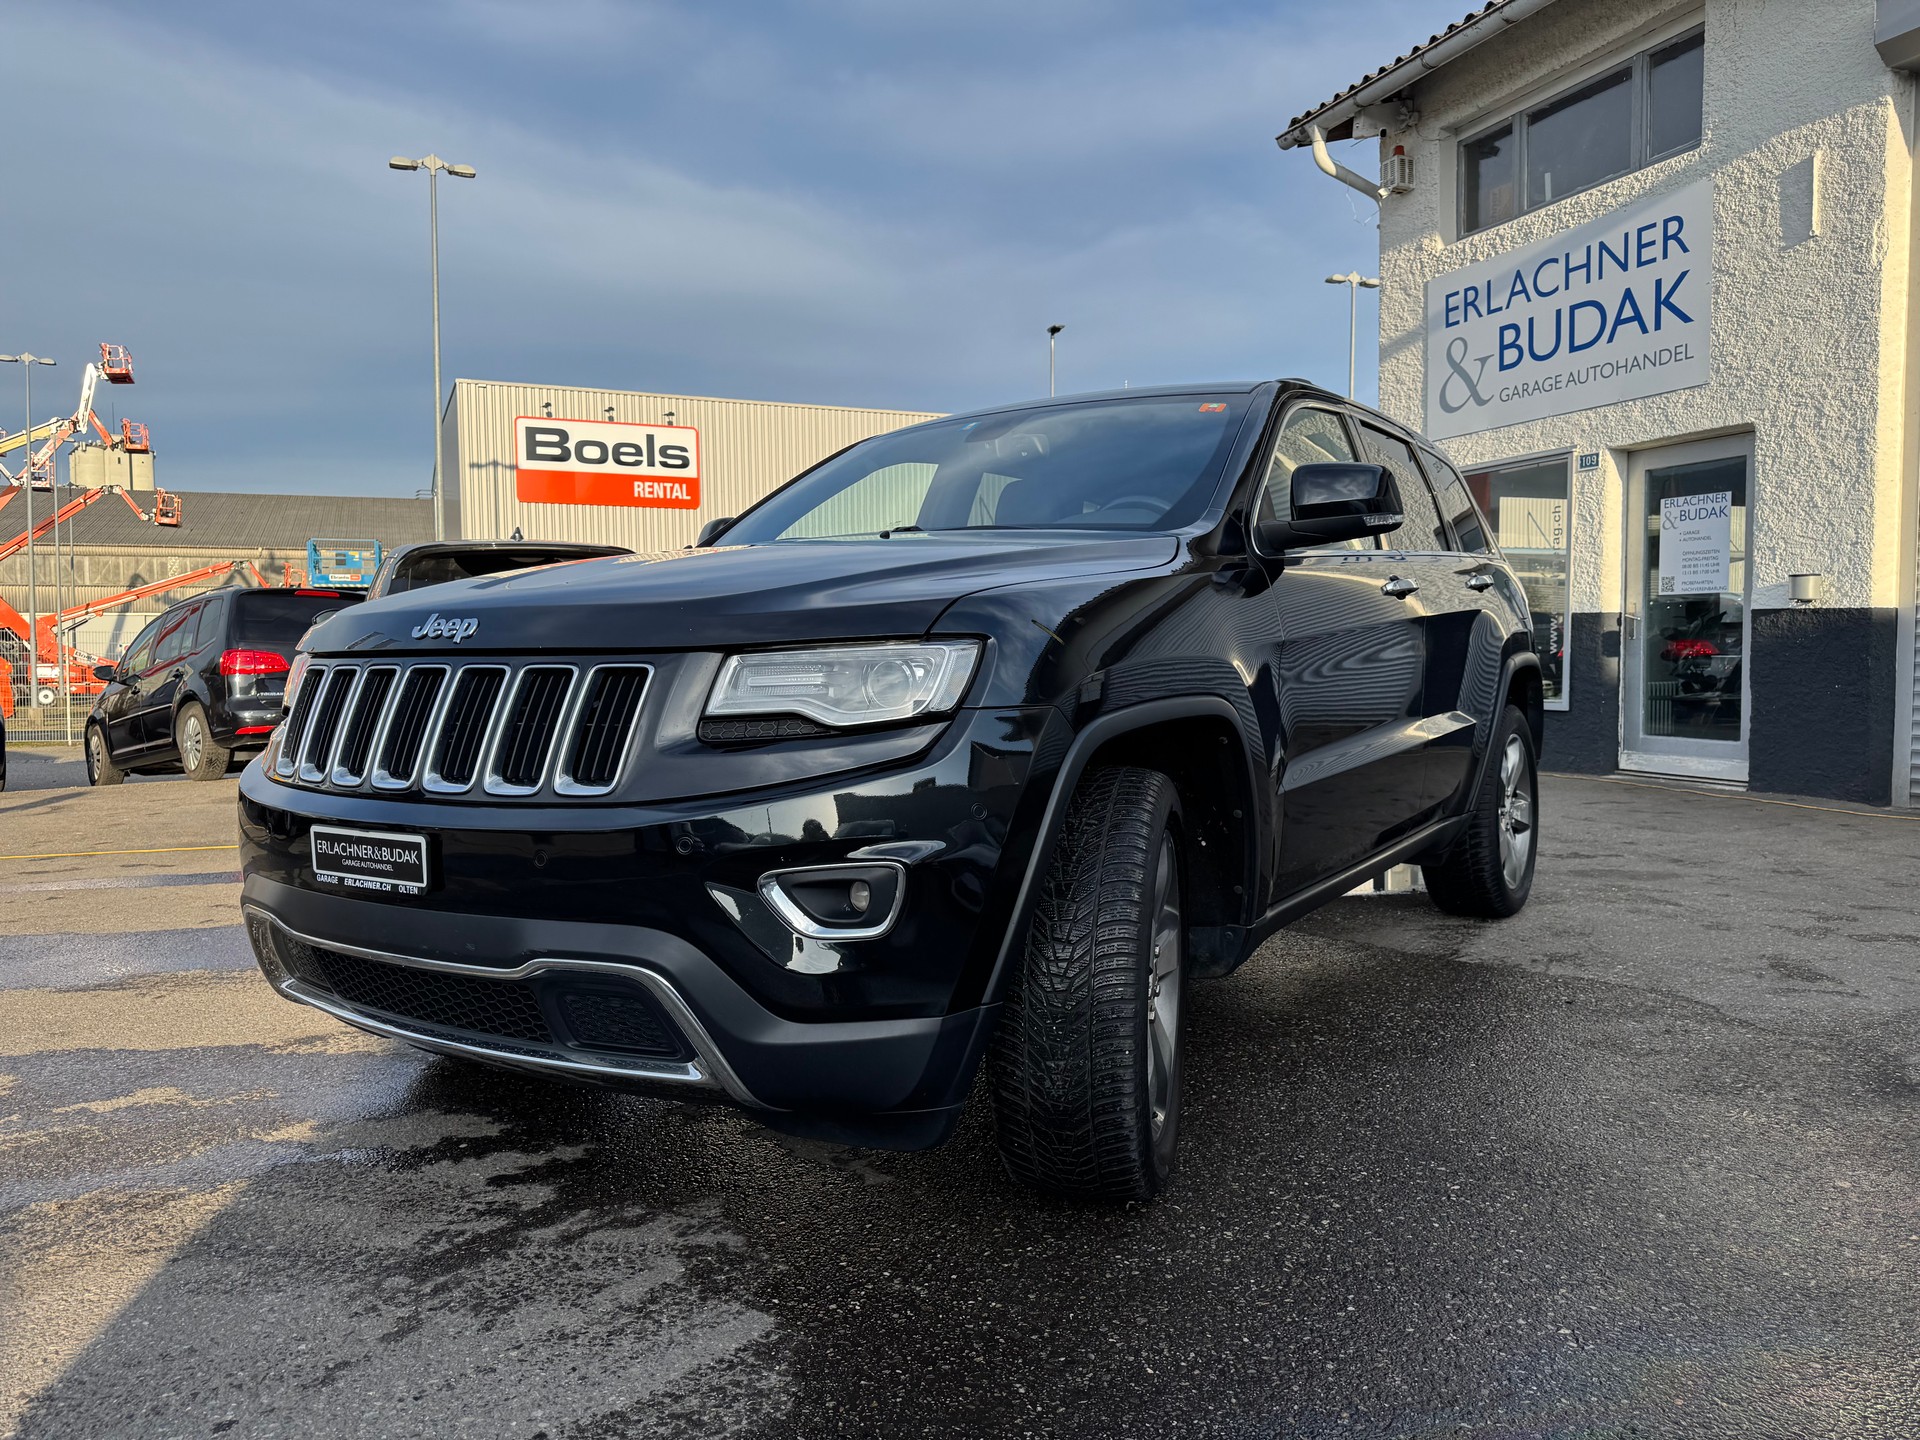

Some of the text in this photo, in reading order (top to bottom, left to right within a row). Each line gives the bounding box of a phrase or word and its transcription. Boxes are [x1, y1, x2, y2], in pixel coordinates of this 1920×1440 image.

[1444, 214, 1691, 329] ERLACHNER
[1438, 268, 1695, 414] & BUDAK
[1499, 342, 1694, 403] GARAGE AUTOHANDEL
[525, 426, 690, 469] Boels
[1582, 455, 1597, 467] 109
[633, 480, 691, 500] RENTAL
[1664, 492, 1728, 509] ERLACHNER
[1662, 505, 1728, 531] & BUDAK
[411, 613, 479, 644] Jeep
[341, 858, 394, 872] GARAGE AUTOHANDEL
[316, 873, 418, 895] GARAGE ERLACHNER.CH OLTEN
